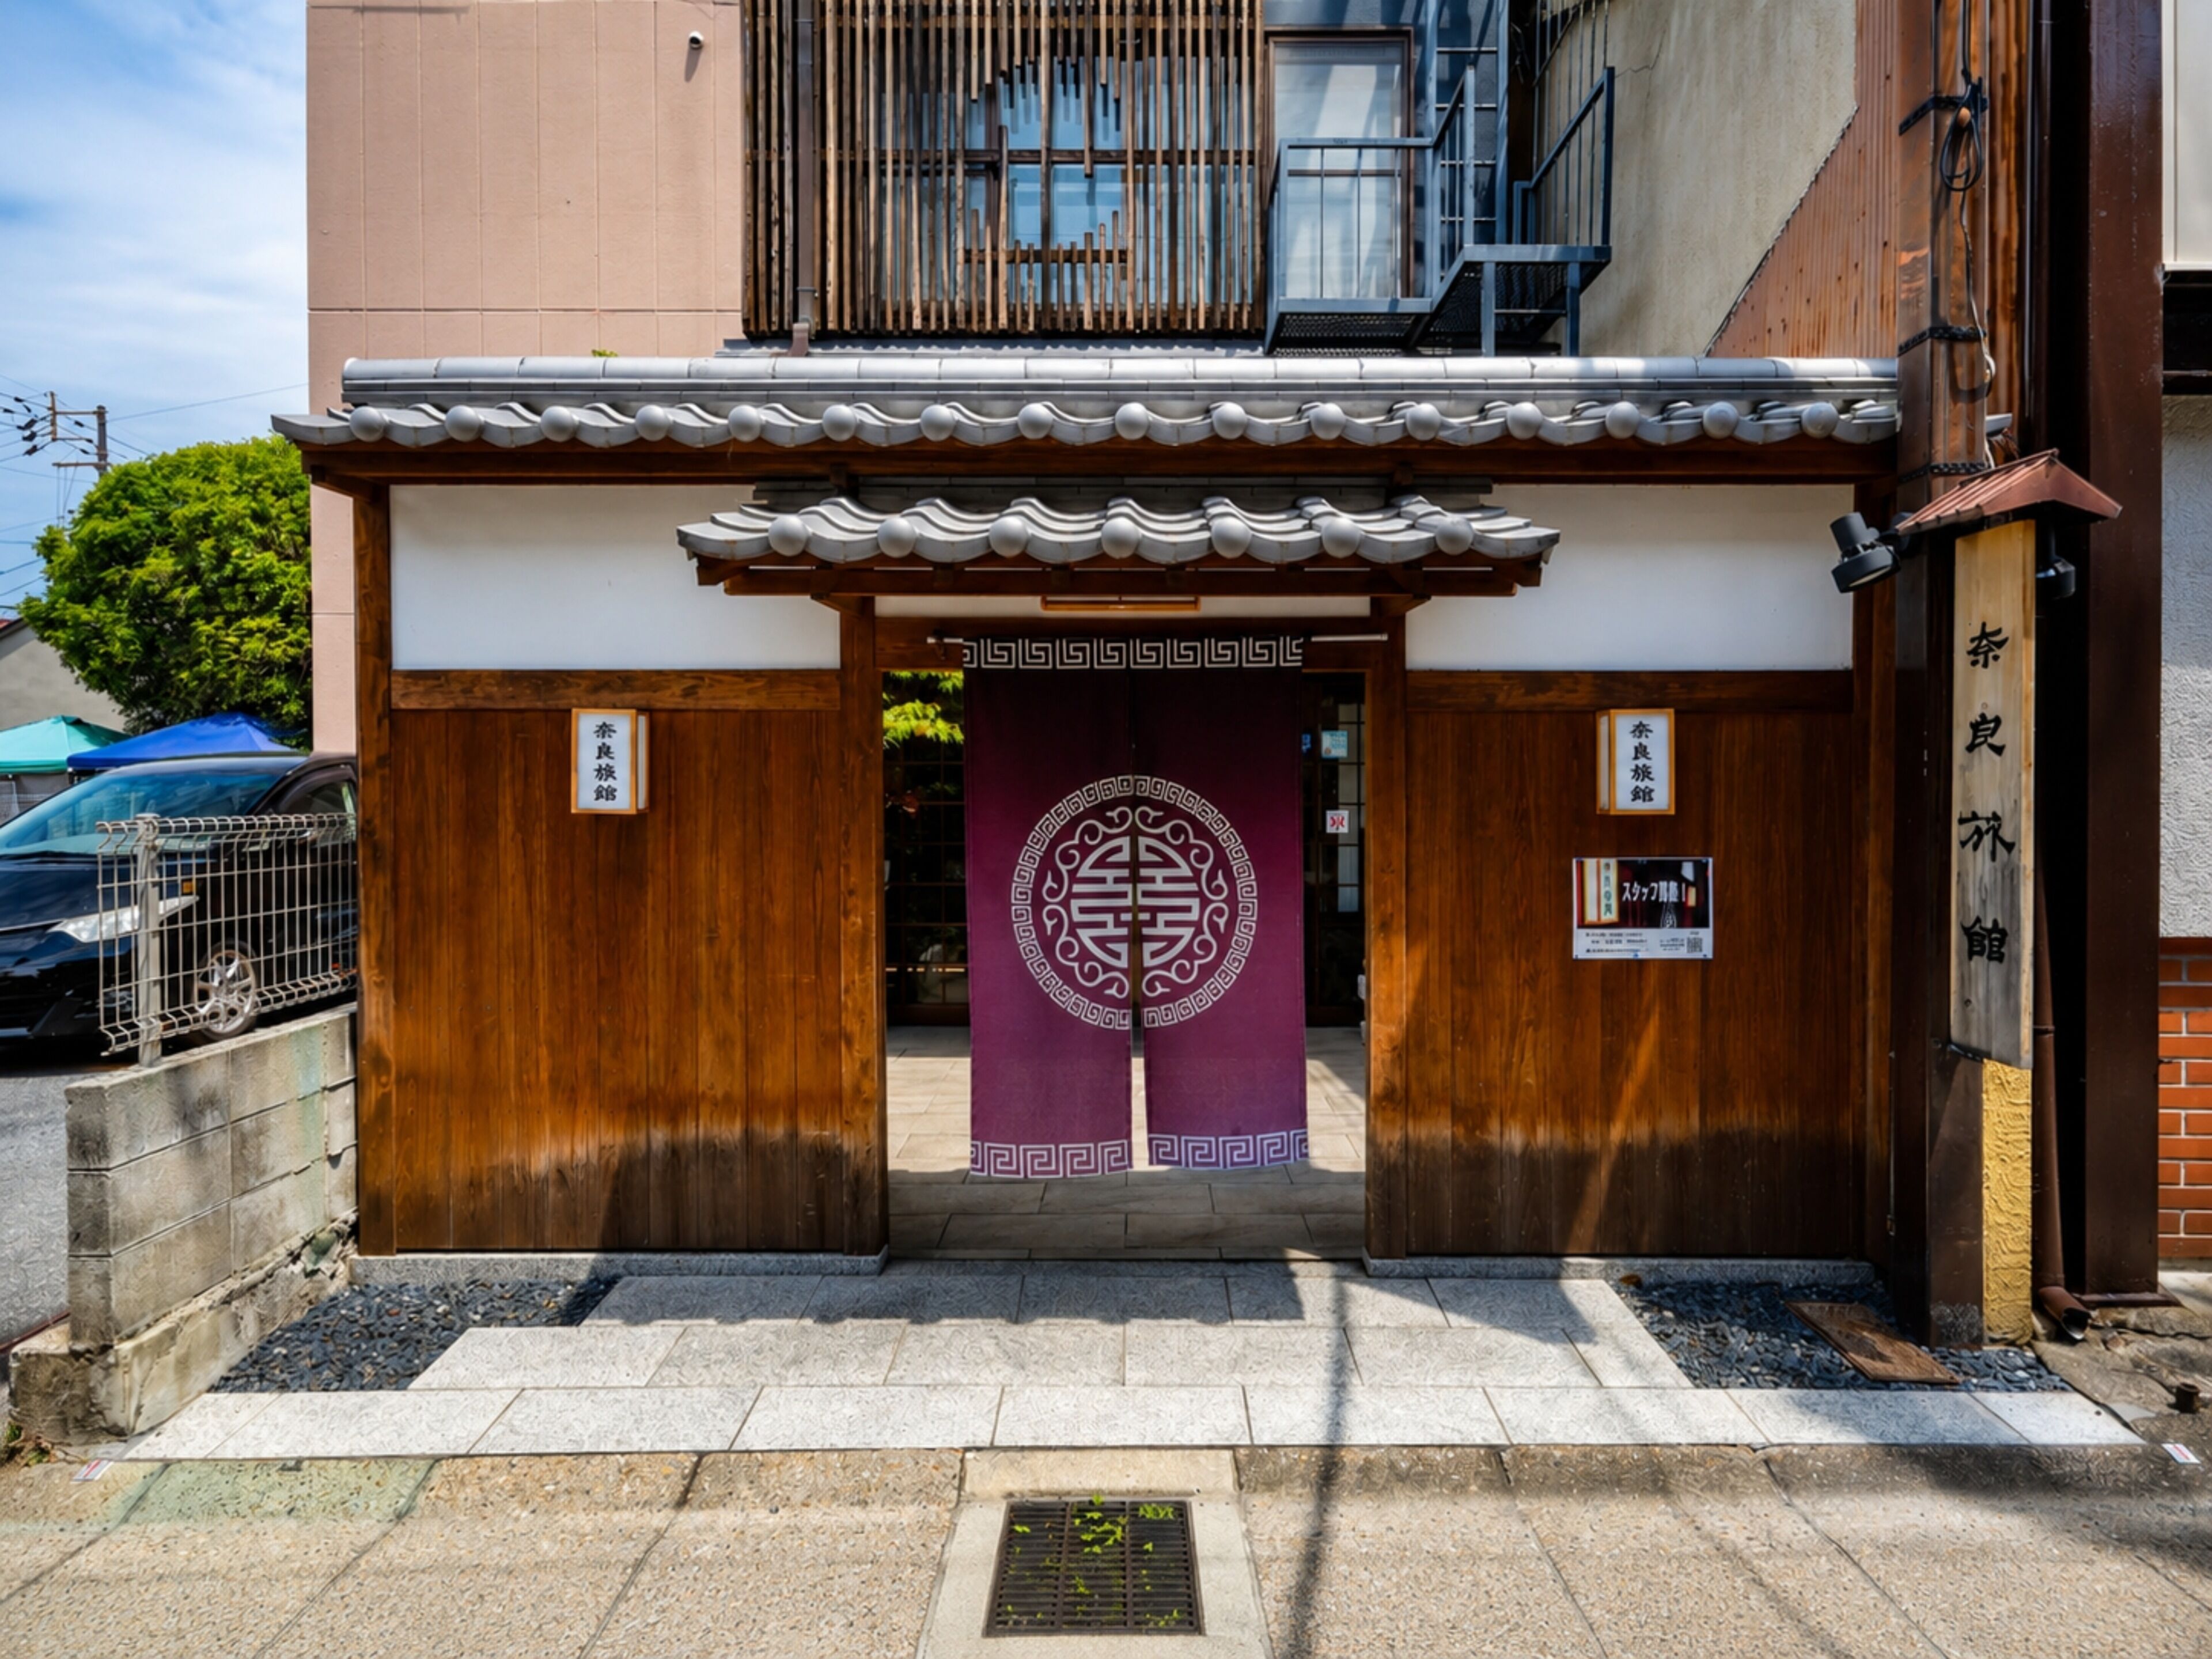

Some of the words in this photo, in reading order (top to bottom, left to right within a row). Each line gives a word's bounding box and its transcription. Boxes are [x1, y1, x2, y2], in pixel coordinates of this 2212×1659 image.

[593, 721, 618, 801] 奈良旅館
[1629, 721, 1655, 802] 奈良旅館
[1957, 622, 2016, 964] 奈良旅館
